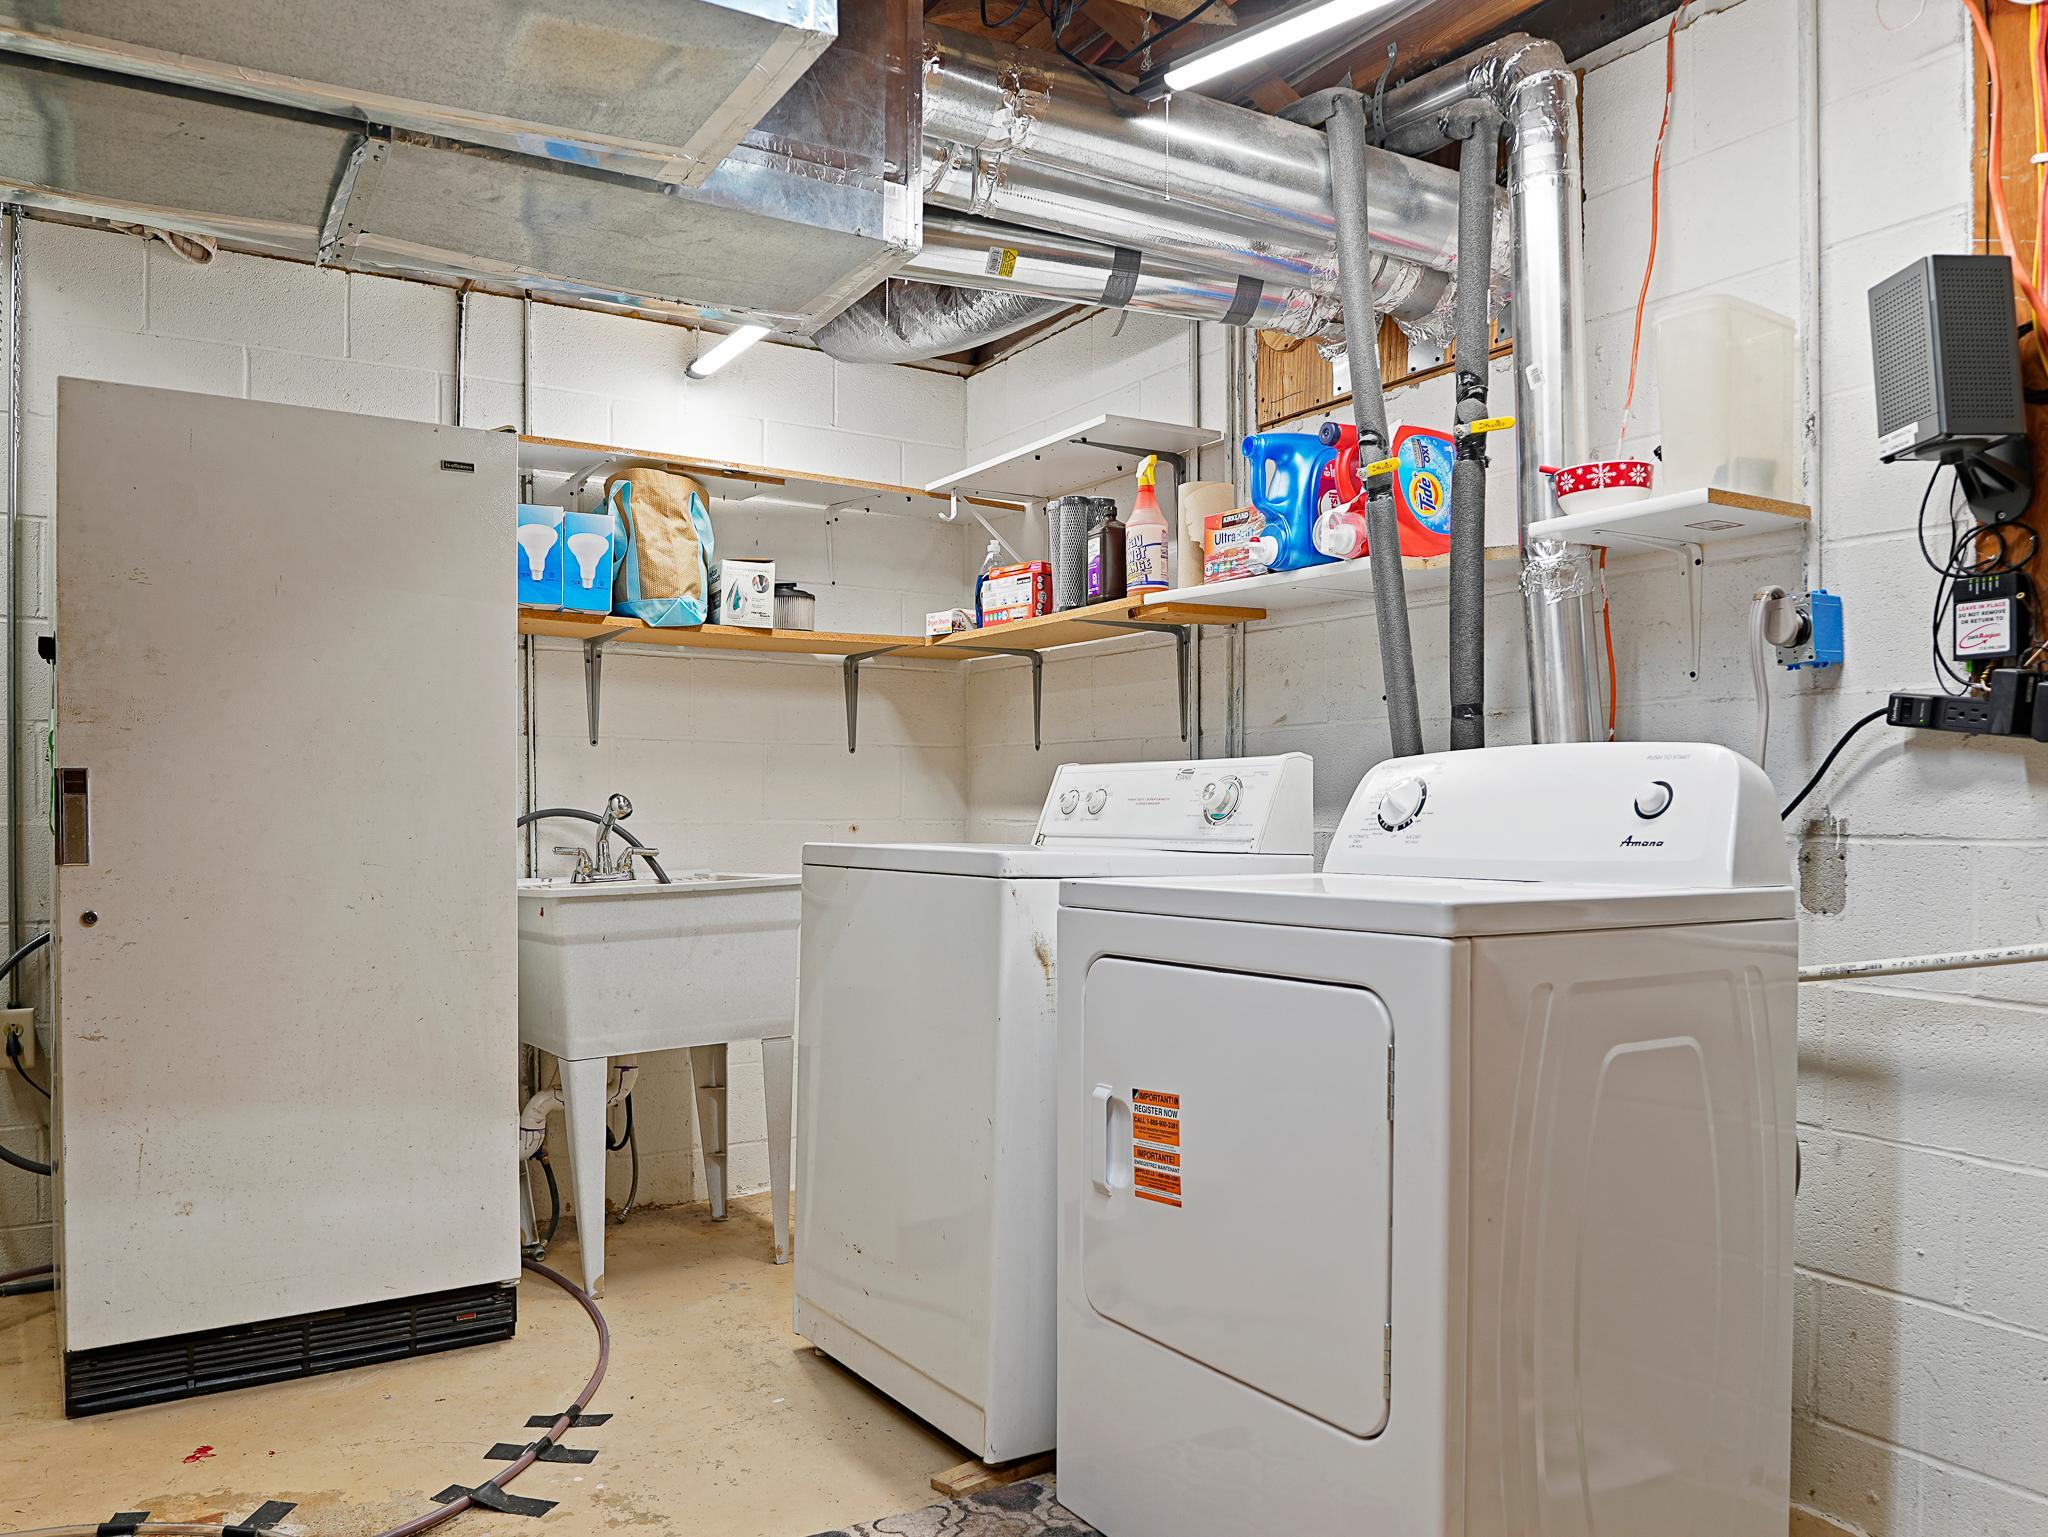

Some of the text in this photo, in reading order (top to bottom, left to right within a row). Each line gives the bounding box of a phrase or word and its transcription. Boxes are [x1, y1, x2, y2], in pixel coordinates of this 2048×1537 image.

[1421, 444, 1431, 464] OXI
[1418, 477, 1436, 511] Tide
[1222, 511, 1249, 524] KIRKLAND
[1214, 532, 1236, 546] Ultra
[1958, 604, 1977, 612] LEAVE
[1981, 608, 2006, 616] REMOVE
[1619, 834, 1664, 847] Amana
[1138, 1092, 1174, 1105] IMPORTANT!
[1133, 1104, 1178, 1119] REGISTER NOW
[1134, 1115, 1145, 1125] CALL
[1137, 1149, 1175, 1164] IMPORTANTE!
